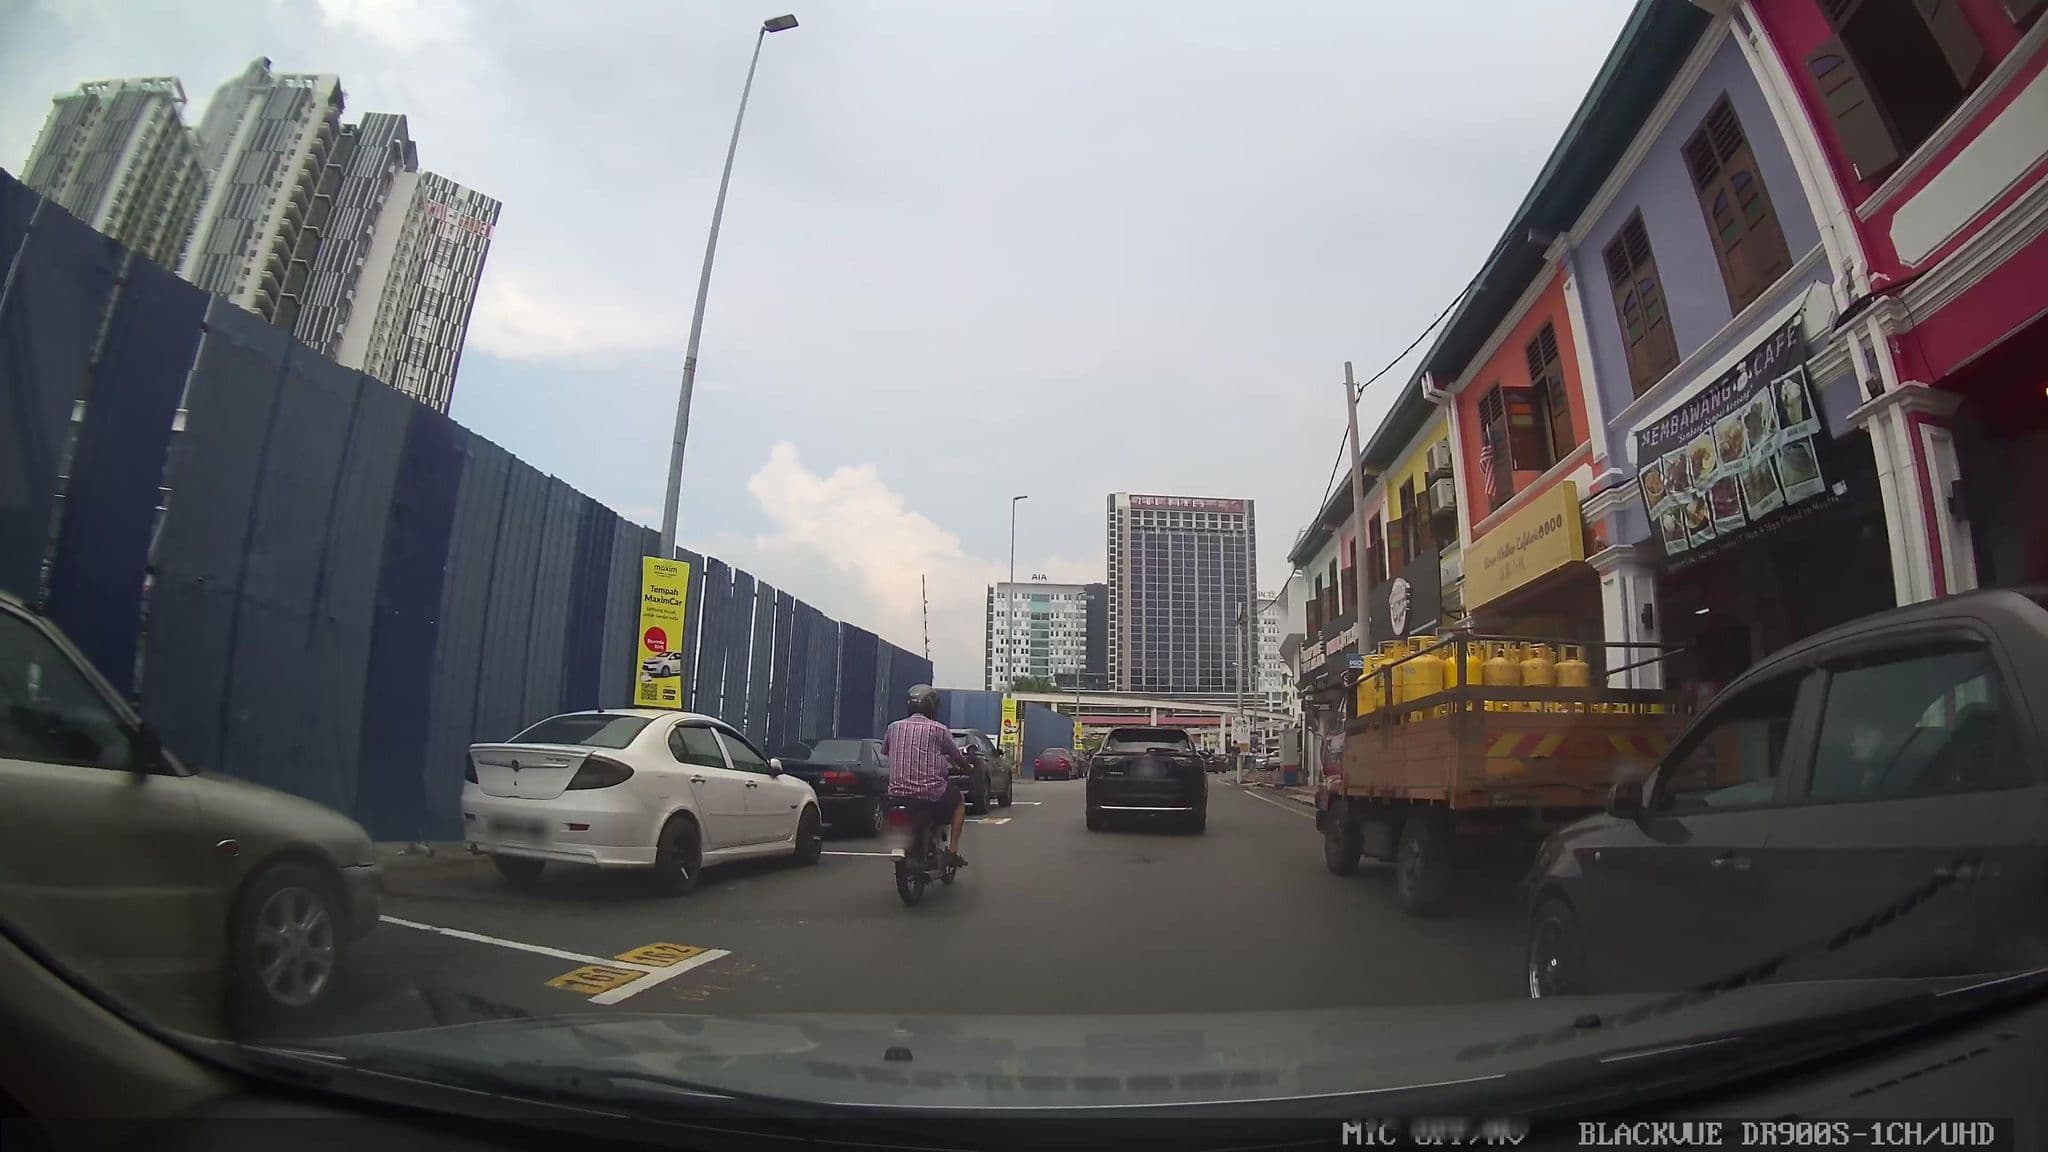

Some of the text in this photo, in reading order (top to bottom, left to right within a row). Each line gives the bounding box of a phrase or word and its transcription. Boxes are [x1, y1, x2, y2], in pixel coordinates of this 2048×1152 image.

[1753, 324, 1798, 377] CAFE
[653, 564, 678, 574] maxim
[1031, 573, 1048, 581] AIA
[649, 584, 679, 596] Tempah
[644, 594, 682, 606] MaximCar
[633, 945, 691, 963] 162
[565, 967, 628, 989] 161
